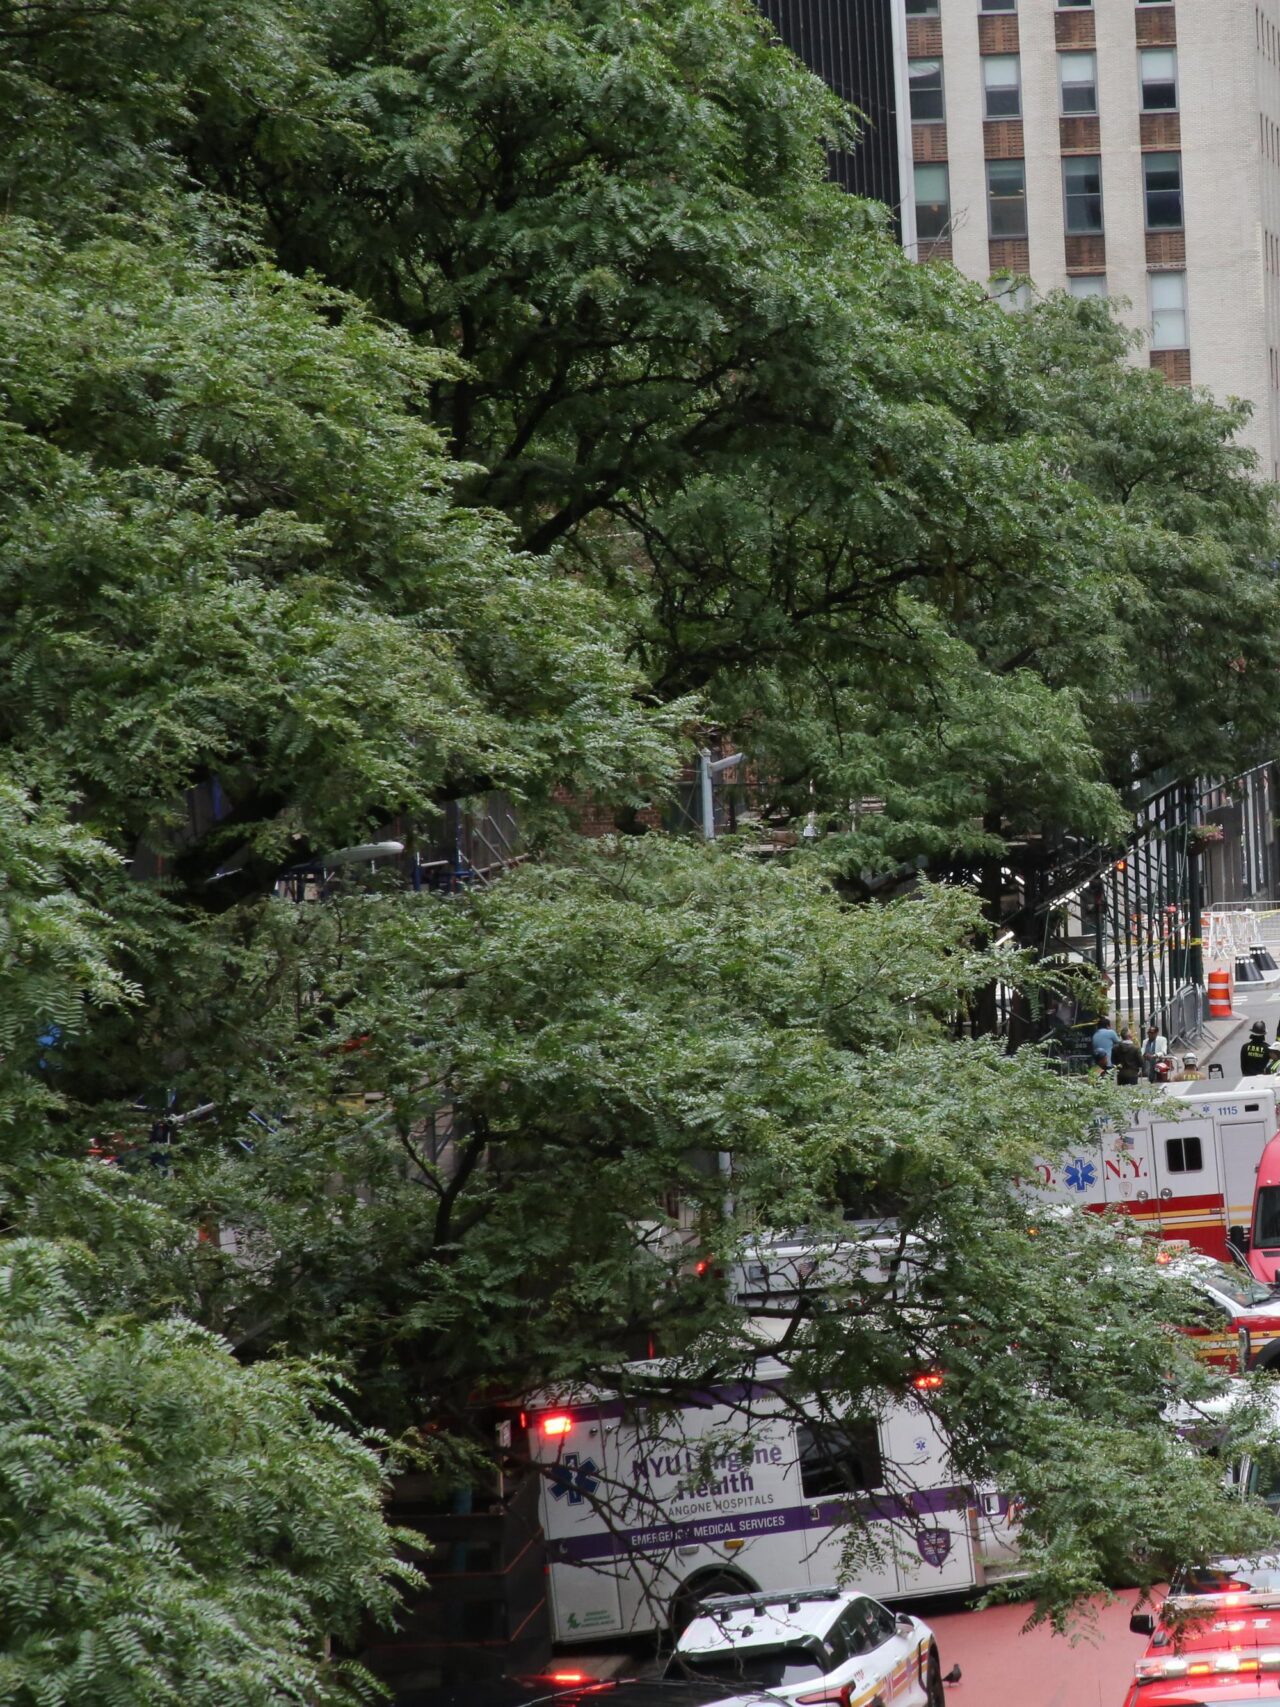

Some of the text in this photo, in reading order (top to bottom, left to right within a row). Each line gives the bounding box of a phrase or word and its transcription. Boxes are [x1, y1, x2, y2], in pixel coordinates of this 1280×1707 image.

[1218, 1106, 1238, 1116] 1115
[1105, 1157, 1148, 1180] N.Y.
[632, 1444, 782, 1481] NYU Lngone
[677, 1472, 754, 1500] Health
[665, 1493, 774, 1517] ANGONE HOSPITALS
[694, 1523, 736, 1537] MEDICAL
[739, 1515, 785, 1530] SERVICES
